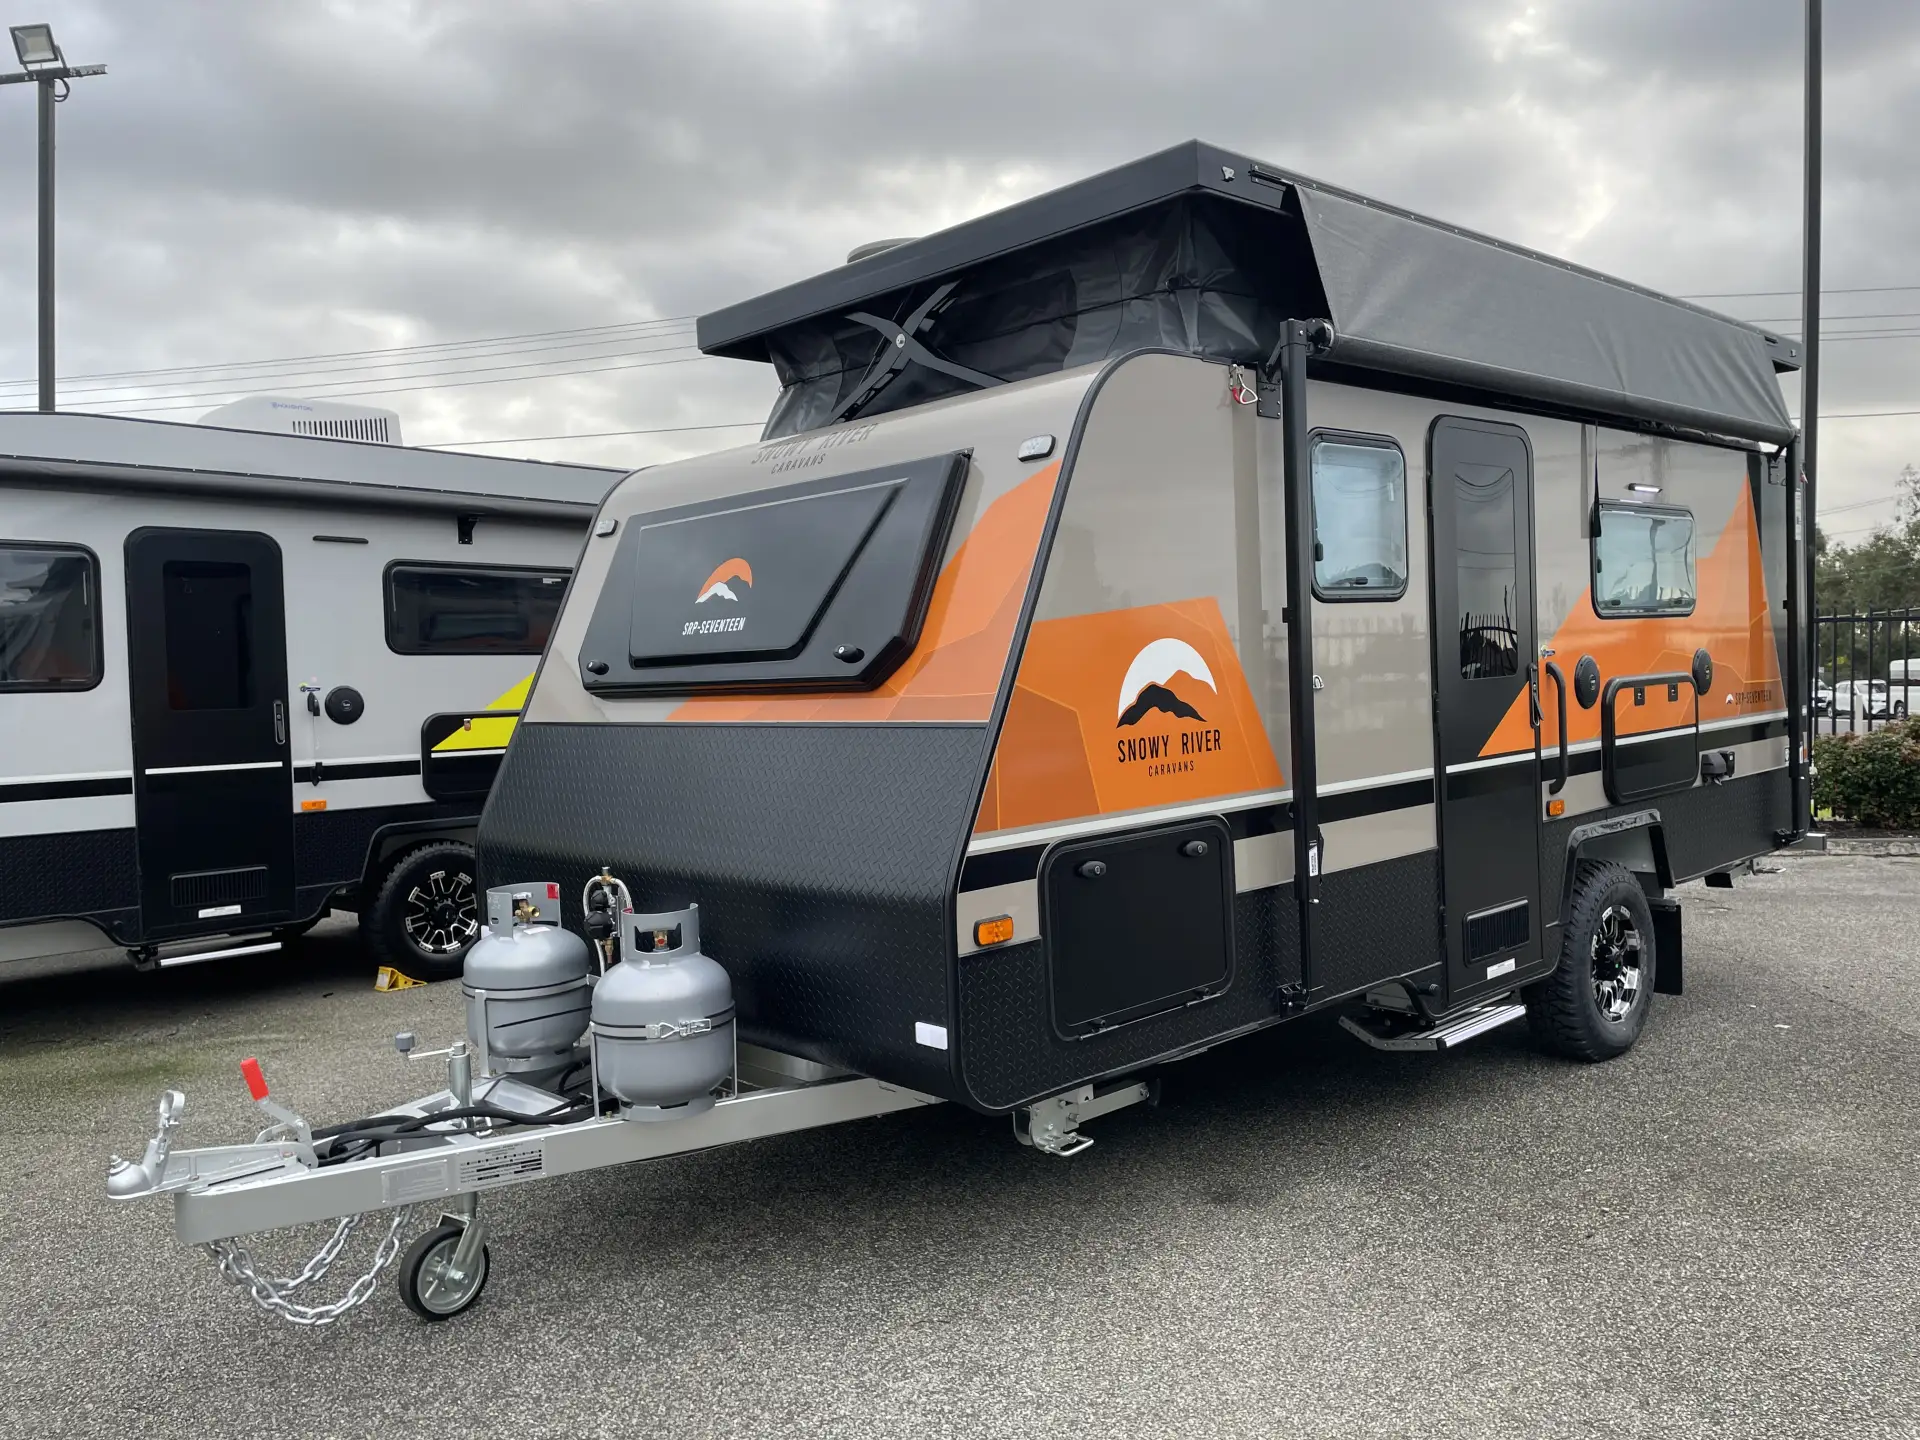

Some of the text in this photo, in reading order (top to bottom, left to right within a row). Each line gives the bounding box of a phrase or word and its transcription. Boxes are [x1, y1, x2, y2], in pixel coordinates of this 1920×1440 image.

[751, 423, 879, 464] SNOWY RIVER
[771, 453, 826, 475] CARAVANS
[682, 617, 746, 636] SRP-SEVENTEEN
[1118, 729, 1222, 763] SNOWY RIVER
[1148, 760, 1195, 777] CARAVANS
